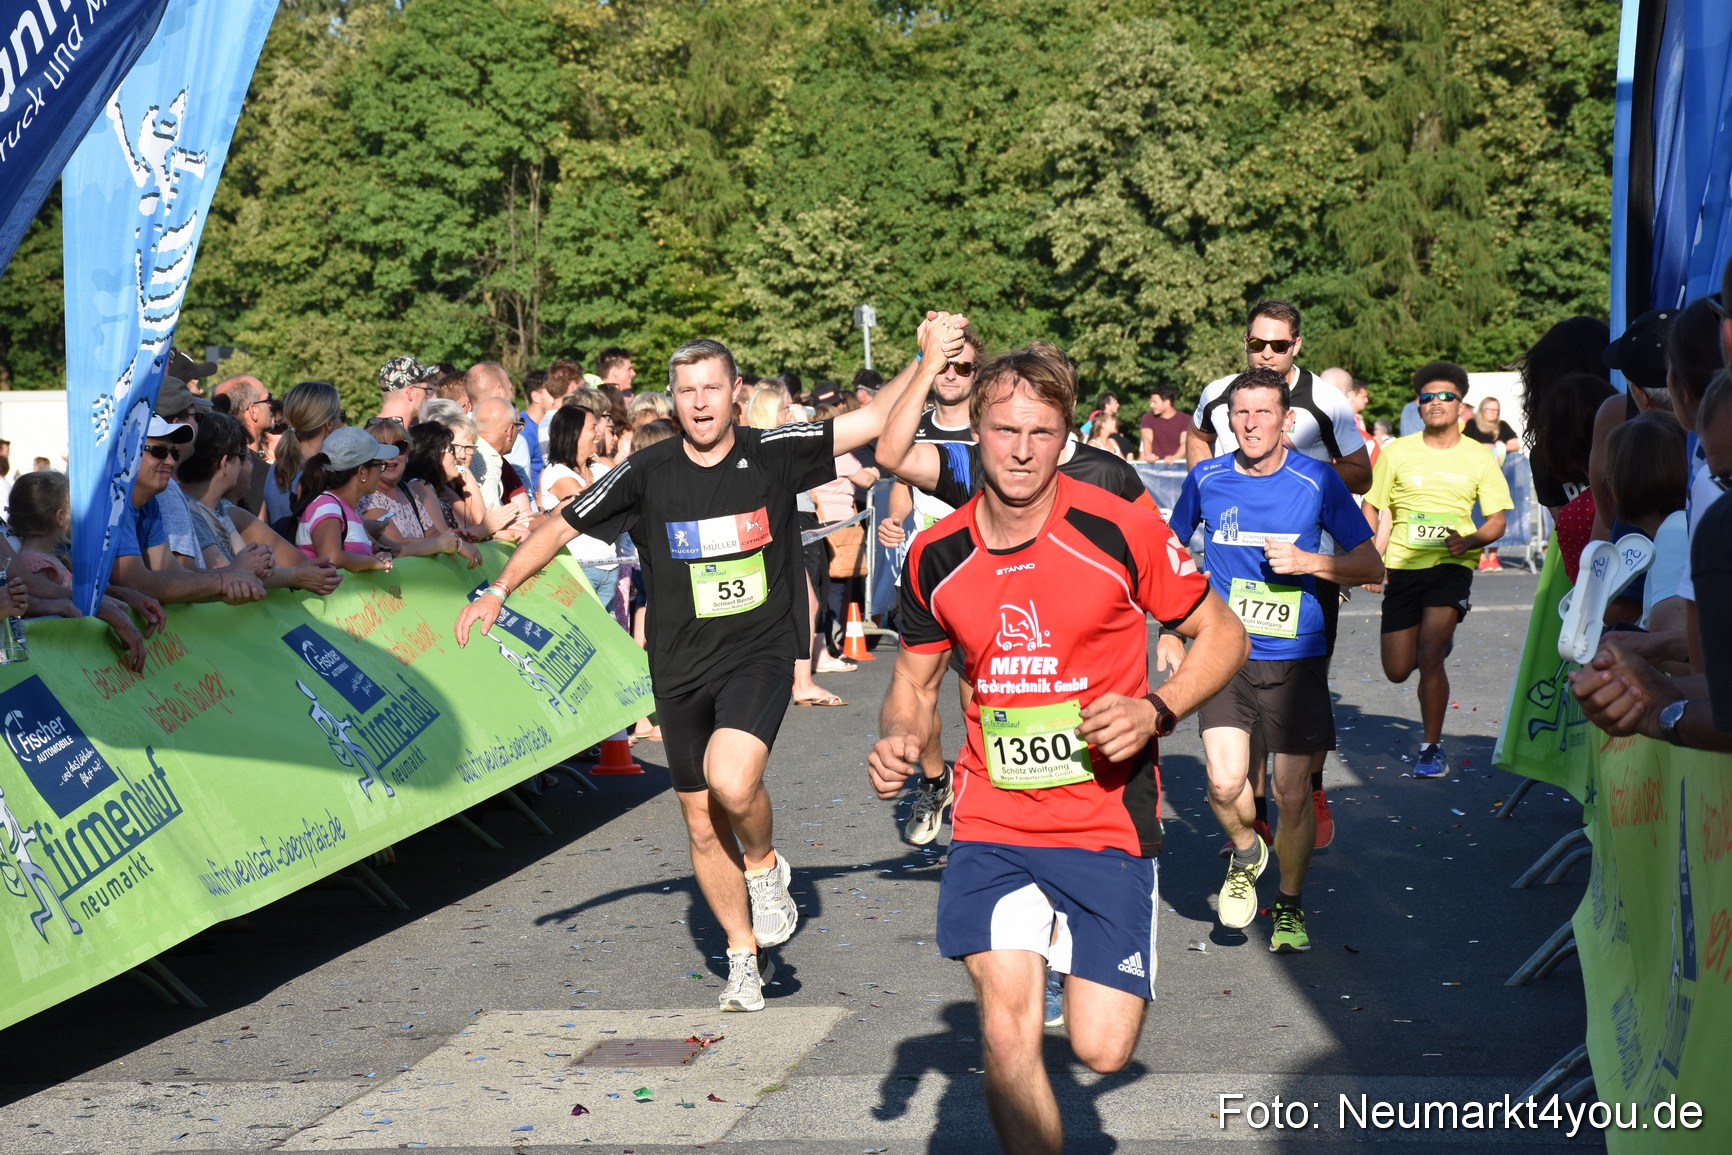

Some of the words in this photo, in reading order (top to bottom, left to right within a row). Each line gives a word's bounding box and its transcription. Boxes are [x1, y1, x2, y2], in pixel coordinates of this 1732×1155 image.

[44, 14, 84, 89] und
[1418, 525, 1446, 538] 972
[703, 540, 737, 552] MÜLLER
[996, 563, 1035, 575] STANNO
[718, 580, 746, 600] 53
[737, 595, 753, 603] Bernd
[1238, 598, 1290, 622] 1779
[1257, 620, 1282, 628] Wolfgang
[990, 656, 1059, 675] MEYER
[1054, 677, 1088, 693] GmbH
[16, 716, 66, 755] Fischer
[36, 735, 74, 764] AUTOMOBILE
[993, 733, 1072, 765] 1360
[1001, 766, 1026, 775] Schötz
[1029, 763, 1070, 774] Wolfgang
[34, 745, 182, 892] firmenlauf
[80, 851, 154, 920] neumarkt
[1117, 963, 1145, 978] adidas
